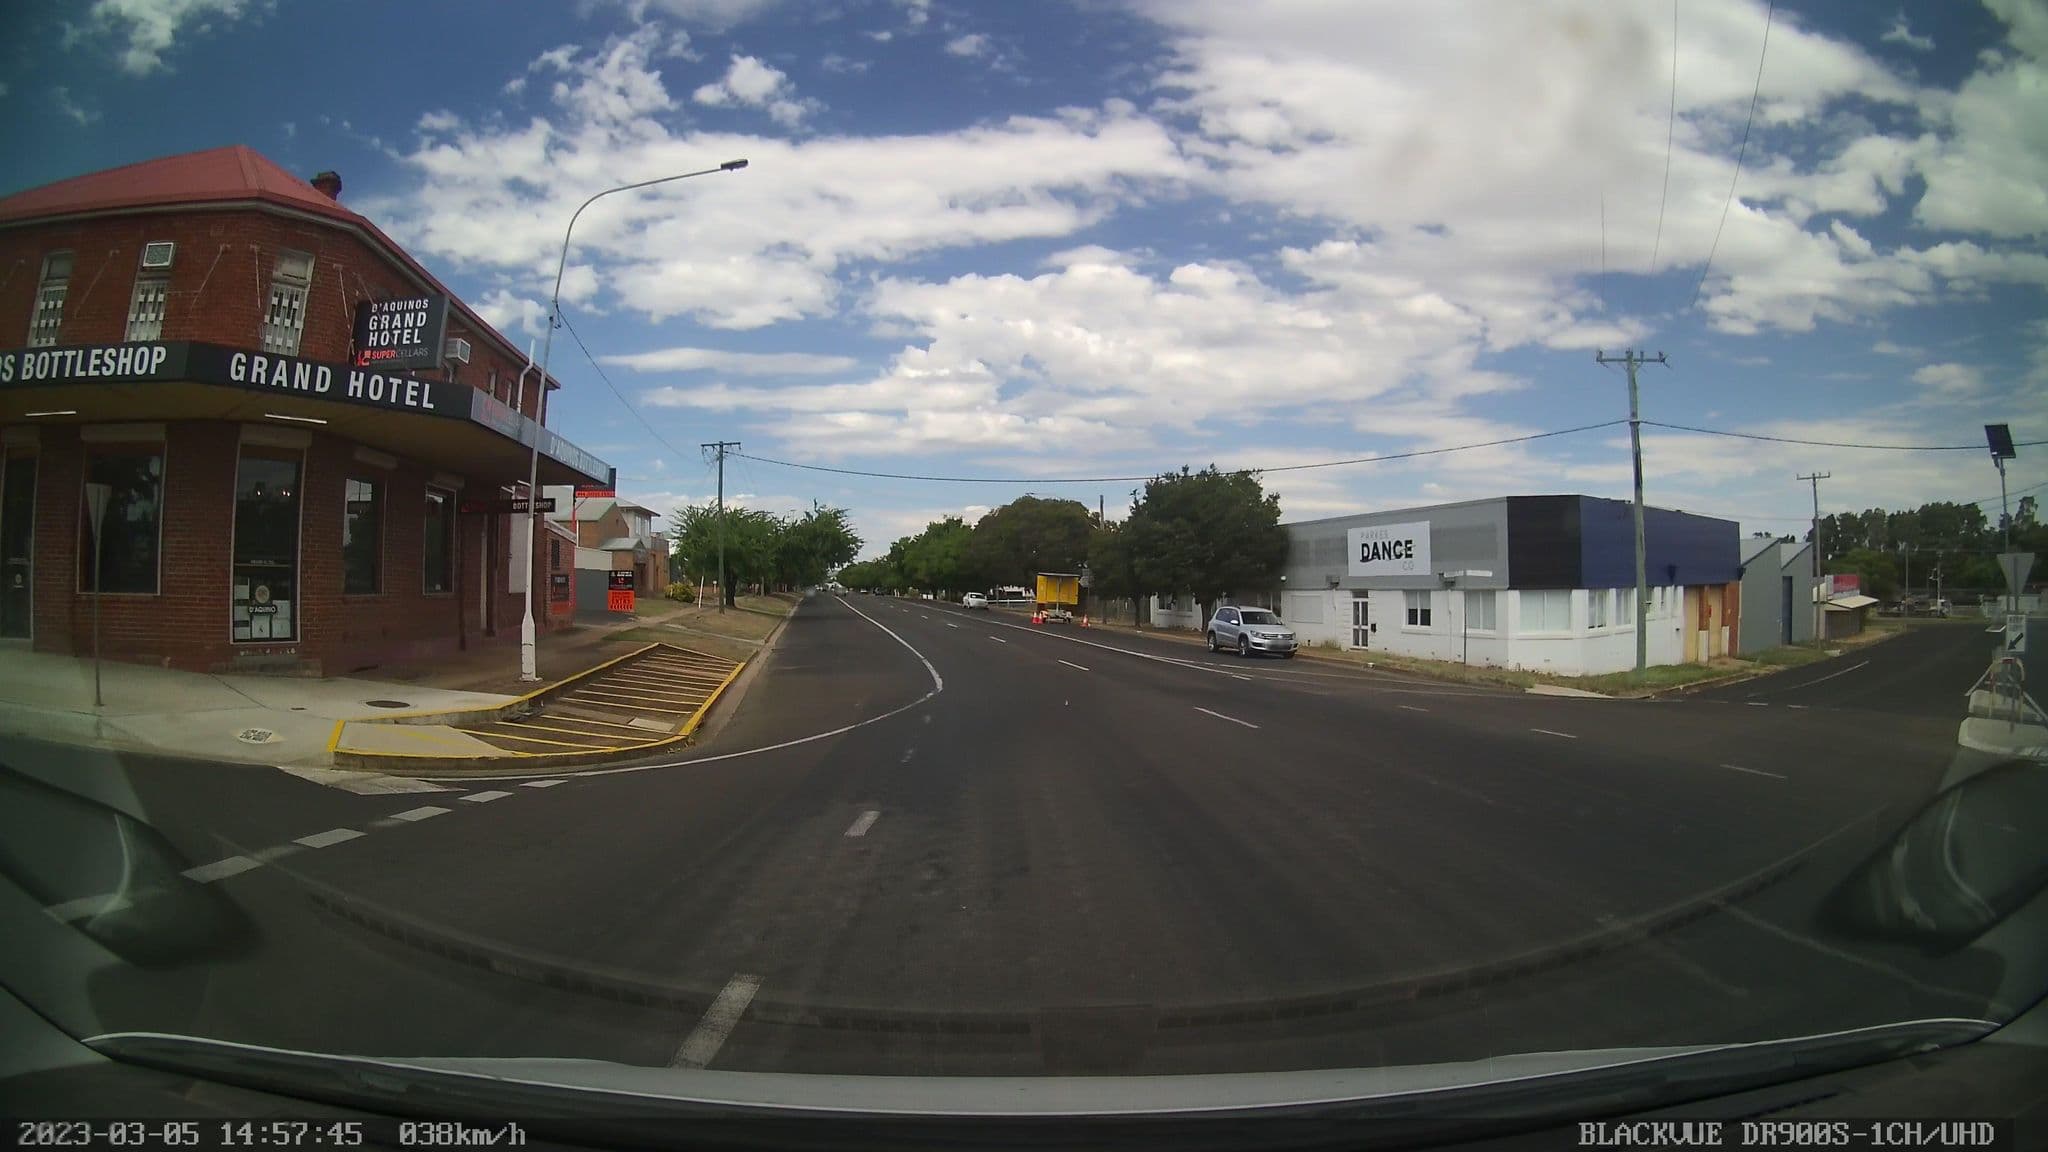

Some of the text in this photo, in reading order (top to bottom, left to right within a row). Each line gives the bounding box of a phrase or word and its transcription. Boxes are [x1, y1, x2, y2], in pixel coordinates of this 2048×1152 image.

[371, 299, 429, 313] D'AQUINOS
[368, 311, 427, 330] GRAND
[368, 328, 422, 347] HOTEL
[21, 346, 167, 381] BOTTLESHOP
[230, 352, 435, 409] GRAND HOTEL
[1360, 539, 1414, 563] DANCE
